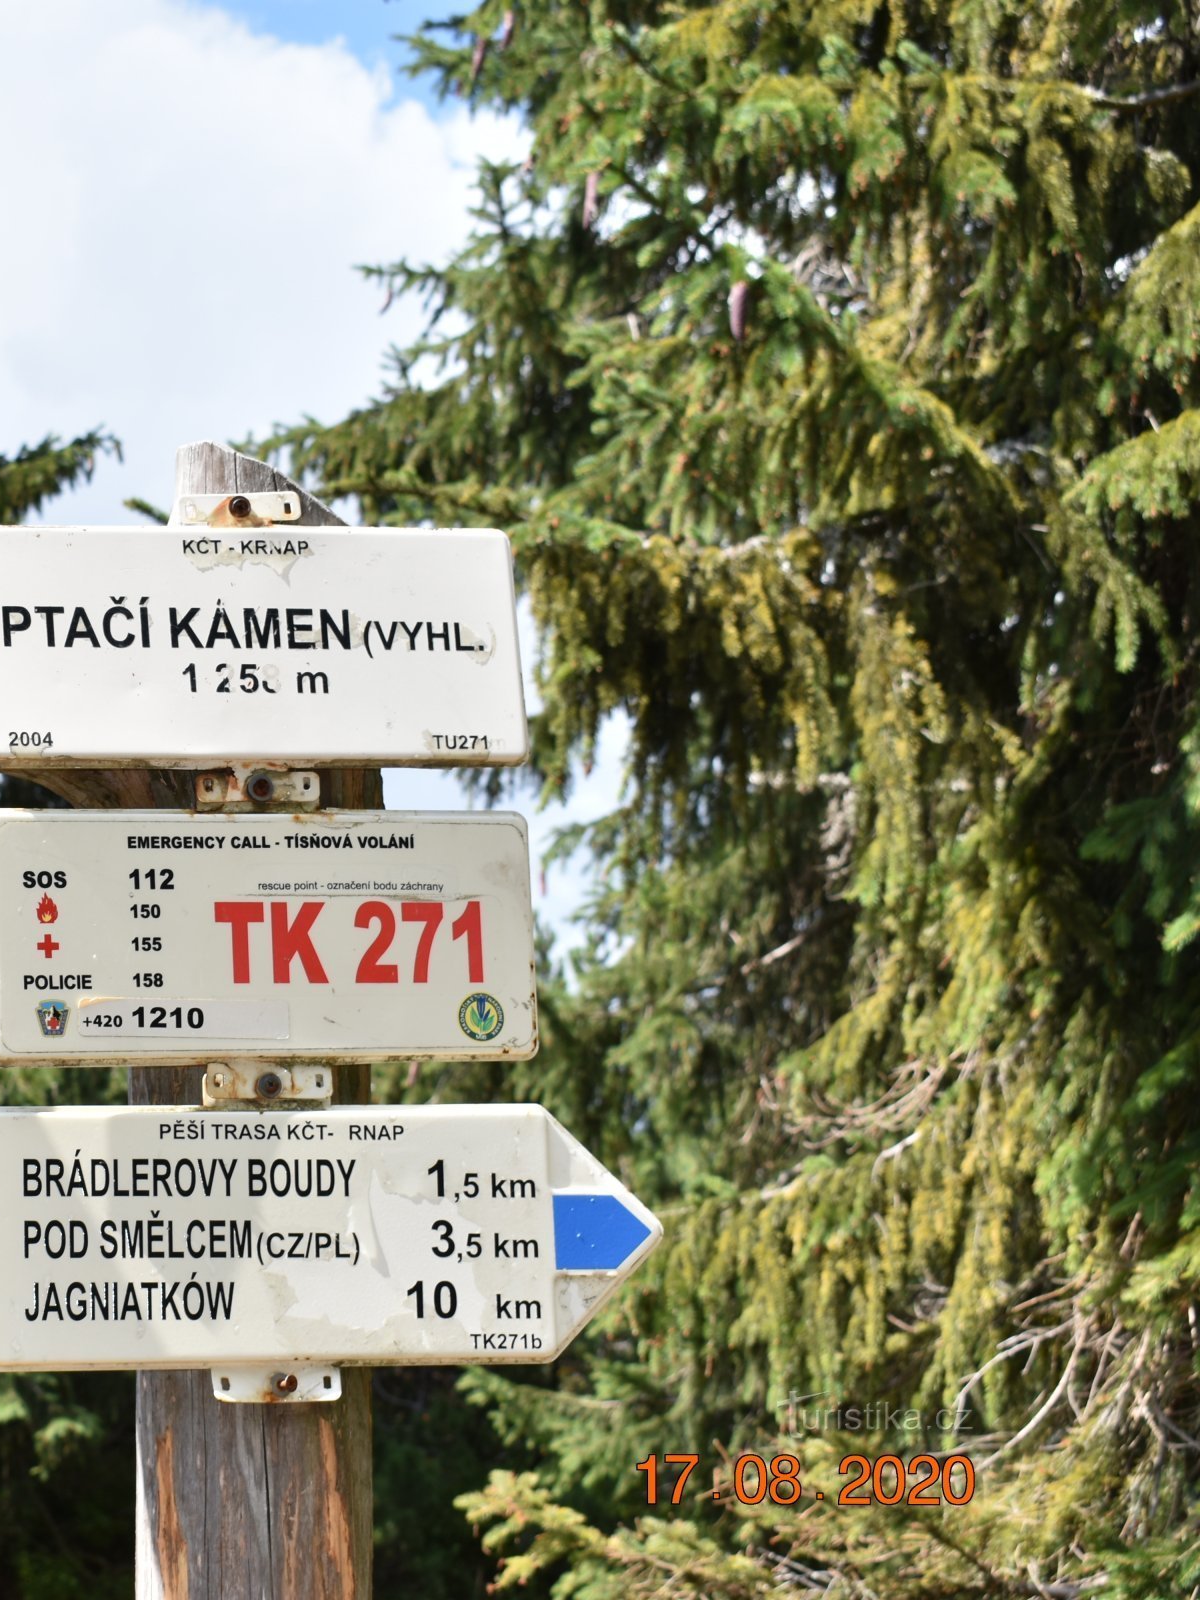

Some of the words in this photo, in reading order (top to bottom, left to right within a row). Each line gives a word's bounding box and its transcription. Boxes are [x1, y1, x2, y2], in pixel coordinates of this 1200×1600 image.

[240, 539, 309, 555] KRNAP
[1, 596, 151, 649] PTAČÍ
[169, 598, 351, 650] KÁMEN
[296, 671, 330, 694] m
[8, 731, 54, 747] 2004
[432, 734, 488, 750] TU271
[127, 835, 226, 849] EMERGENCY
[230, 835, 271, 849] CALL
[284, 833, 354, 849] TÍSŇOVÁ
[357, 833, 415, 849] VOLÁNÍ
[22, 870, 68, 889] SOS
[128, 868, 175, 890] 112
[257, 882, 291, 890] rescue
[294, 880, 318, 892] point
[326, 880, 371, 891] označení
[373, 880, 398, 891] bodu
[400, 881, 444, 893] záchrany
[130, 903, 161, 919] 150
[131, 936, 163, 952] 155
[214, 901, 330, 984] TK
[353, 900, 484, 984] 271
[23, 974, 93, 990] POLICIE
[132, 972, 164, 988] 158
[82, 1014, 123, 1028] +420
[132, 1006, 205, 1029] 1210
[159, 1119, 205, 1140] PĚŠÍ
[211, 1123, 281, 1140] TRASA
[349, 1124, 404, 1141] RNAP
[23, 1149, 238, 1198] BRÁDLEROVY
[247, 1158, 356, 1198] BOUDY
[427, 1159, 480, 1203] 1,5
[491, 1172, 536, 1198] km
[24, 1219, 89, 1259] POD
[99, 1210, 252, 1259] SMĚLCEM
[256, 1231, 360, 1266] (CZ/PL)
[431, 1219, 482, 1263] 3,5
[494, 1232, 539, 1258] km
[25, 1271, 235, 1322] JAGNIATKÓW
[407, 1280, 458, 1319] 10
[496, 1293, 542, 1319] km
[470, 1333, 542, 1350] TK271b
